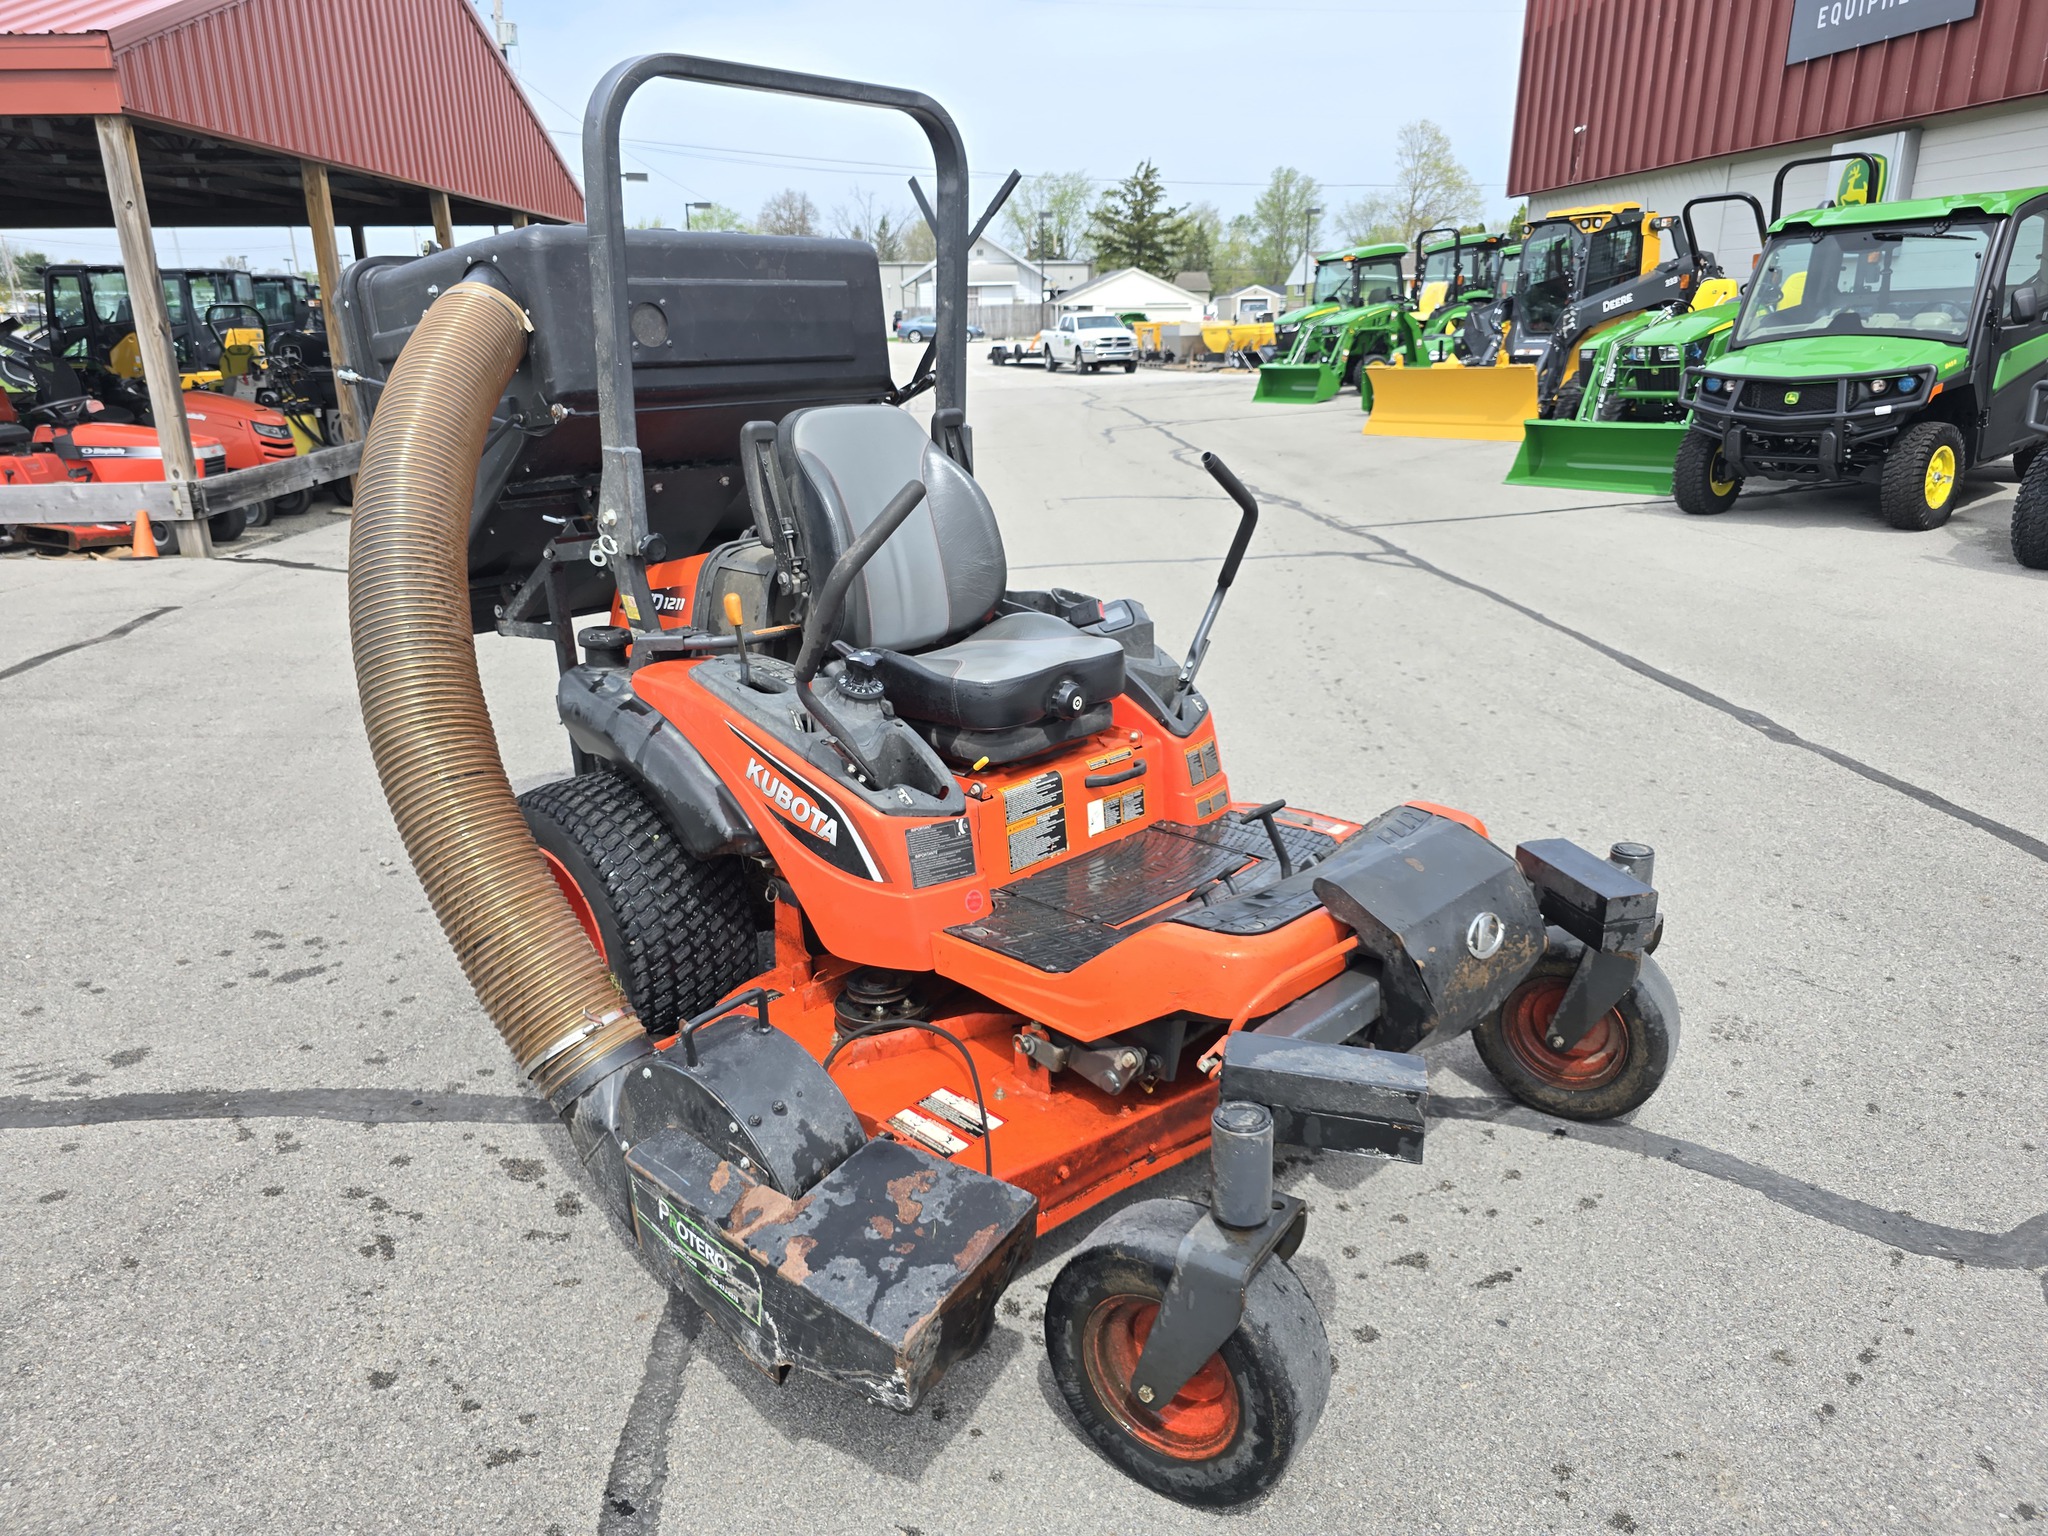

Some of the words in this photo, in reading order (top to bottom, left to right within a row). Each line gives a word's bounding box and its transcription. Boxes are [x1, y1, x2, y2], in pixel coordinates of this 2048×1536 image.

[1817, 0, 1909, 29] EQUIP
[1602, 293, 1634, 313] DEERE
[651, 593, 686, 611] D1211
[745, 757, 838, 847] KUBOTA
[658, 1198, 728, 1273] PROTERO
